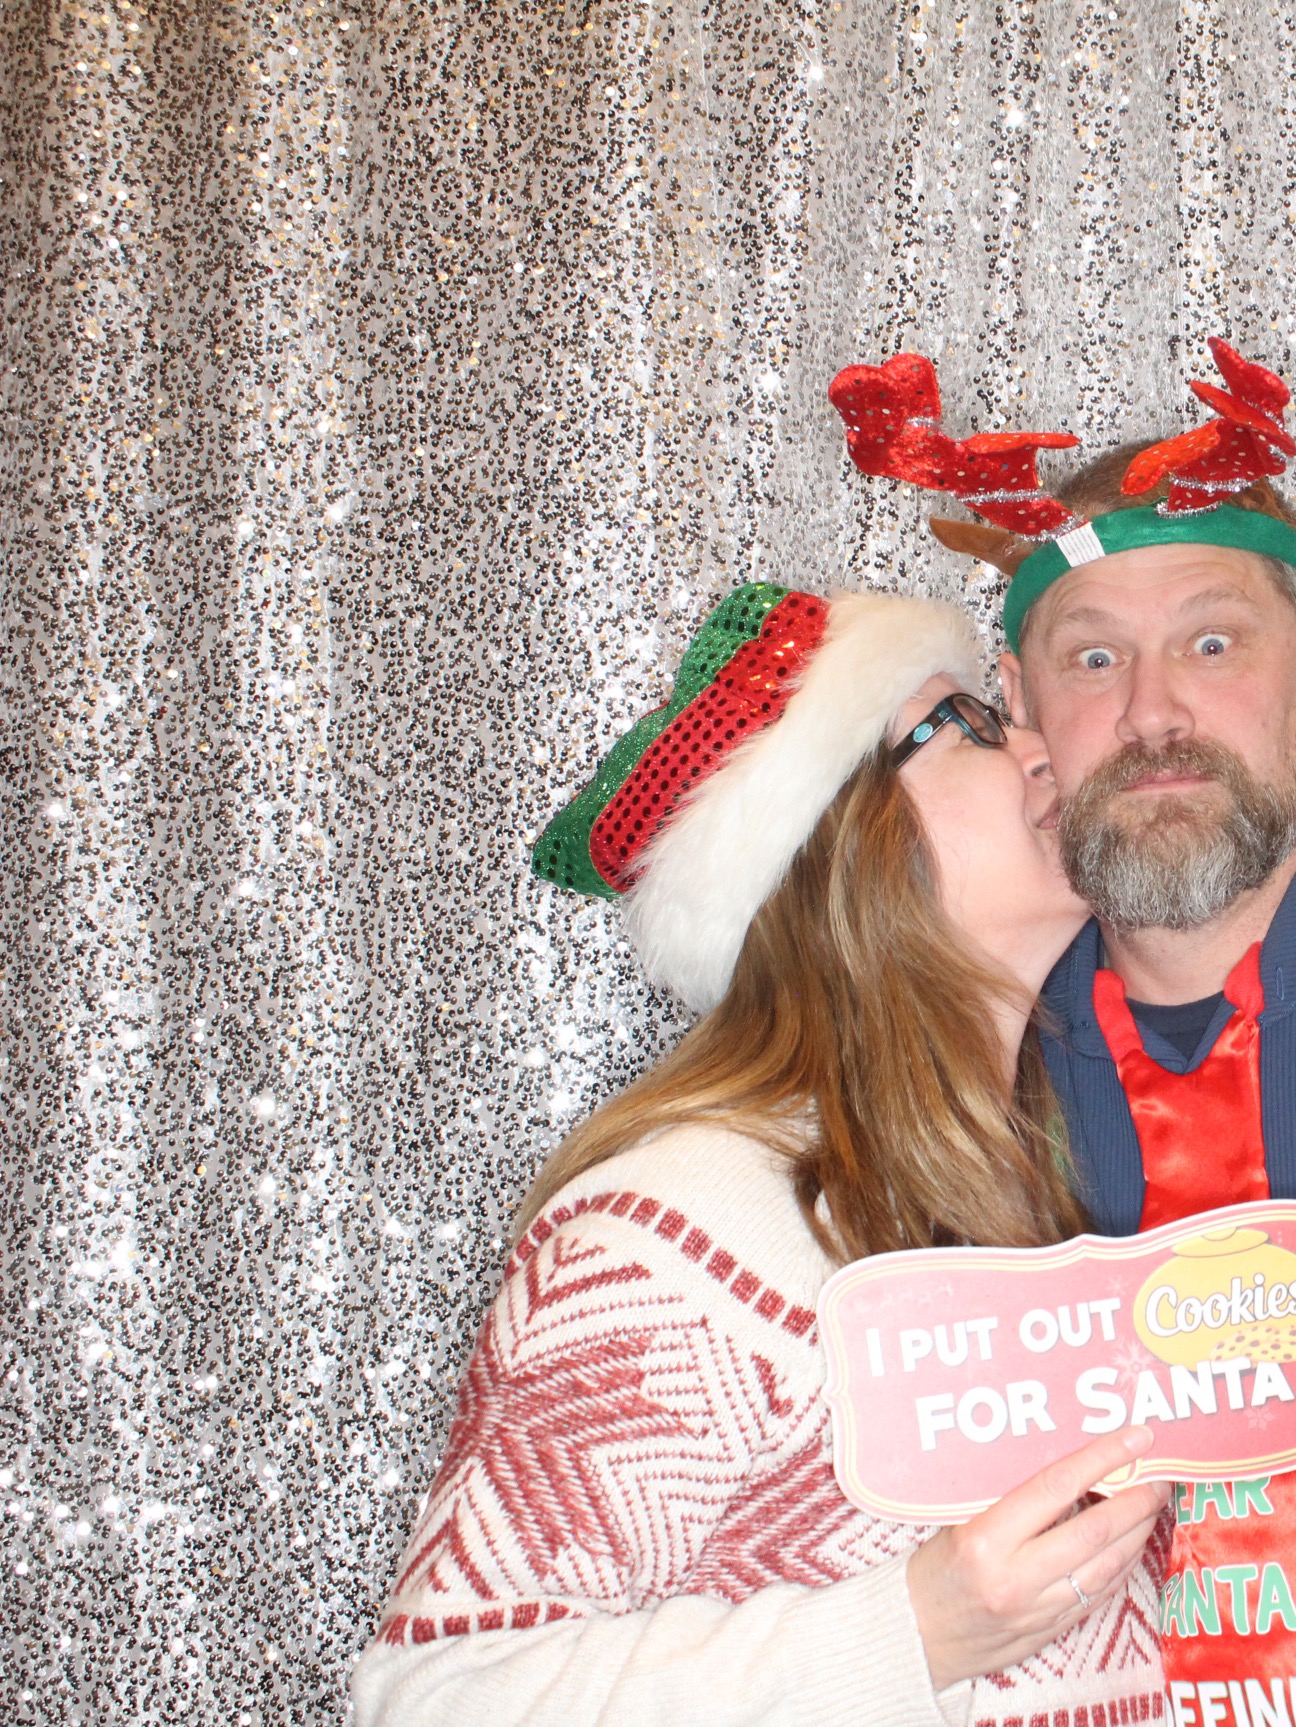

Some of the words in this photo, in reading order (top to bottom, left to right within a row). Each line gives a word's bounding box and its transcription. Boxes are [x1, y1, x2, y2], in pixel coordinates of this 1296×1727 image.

[866, 1328, 885, 1377] I
[899, 1316, 999, 1373] PUT
[1018, 1297, 1122, 1354] OUT
[915, 1379, 1057, 1451] FOR
[1075, 1357, 1295, 1434] SANTA
